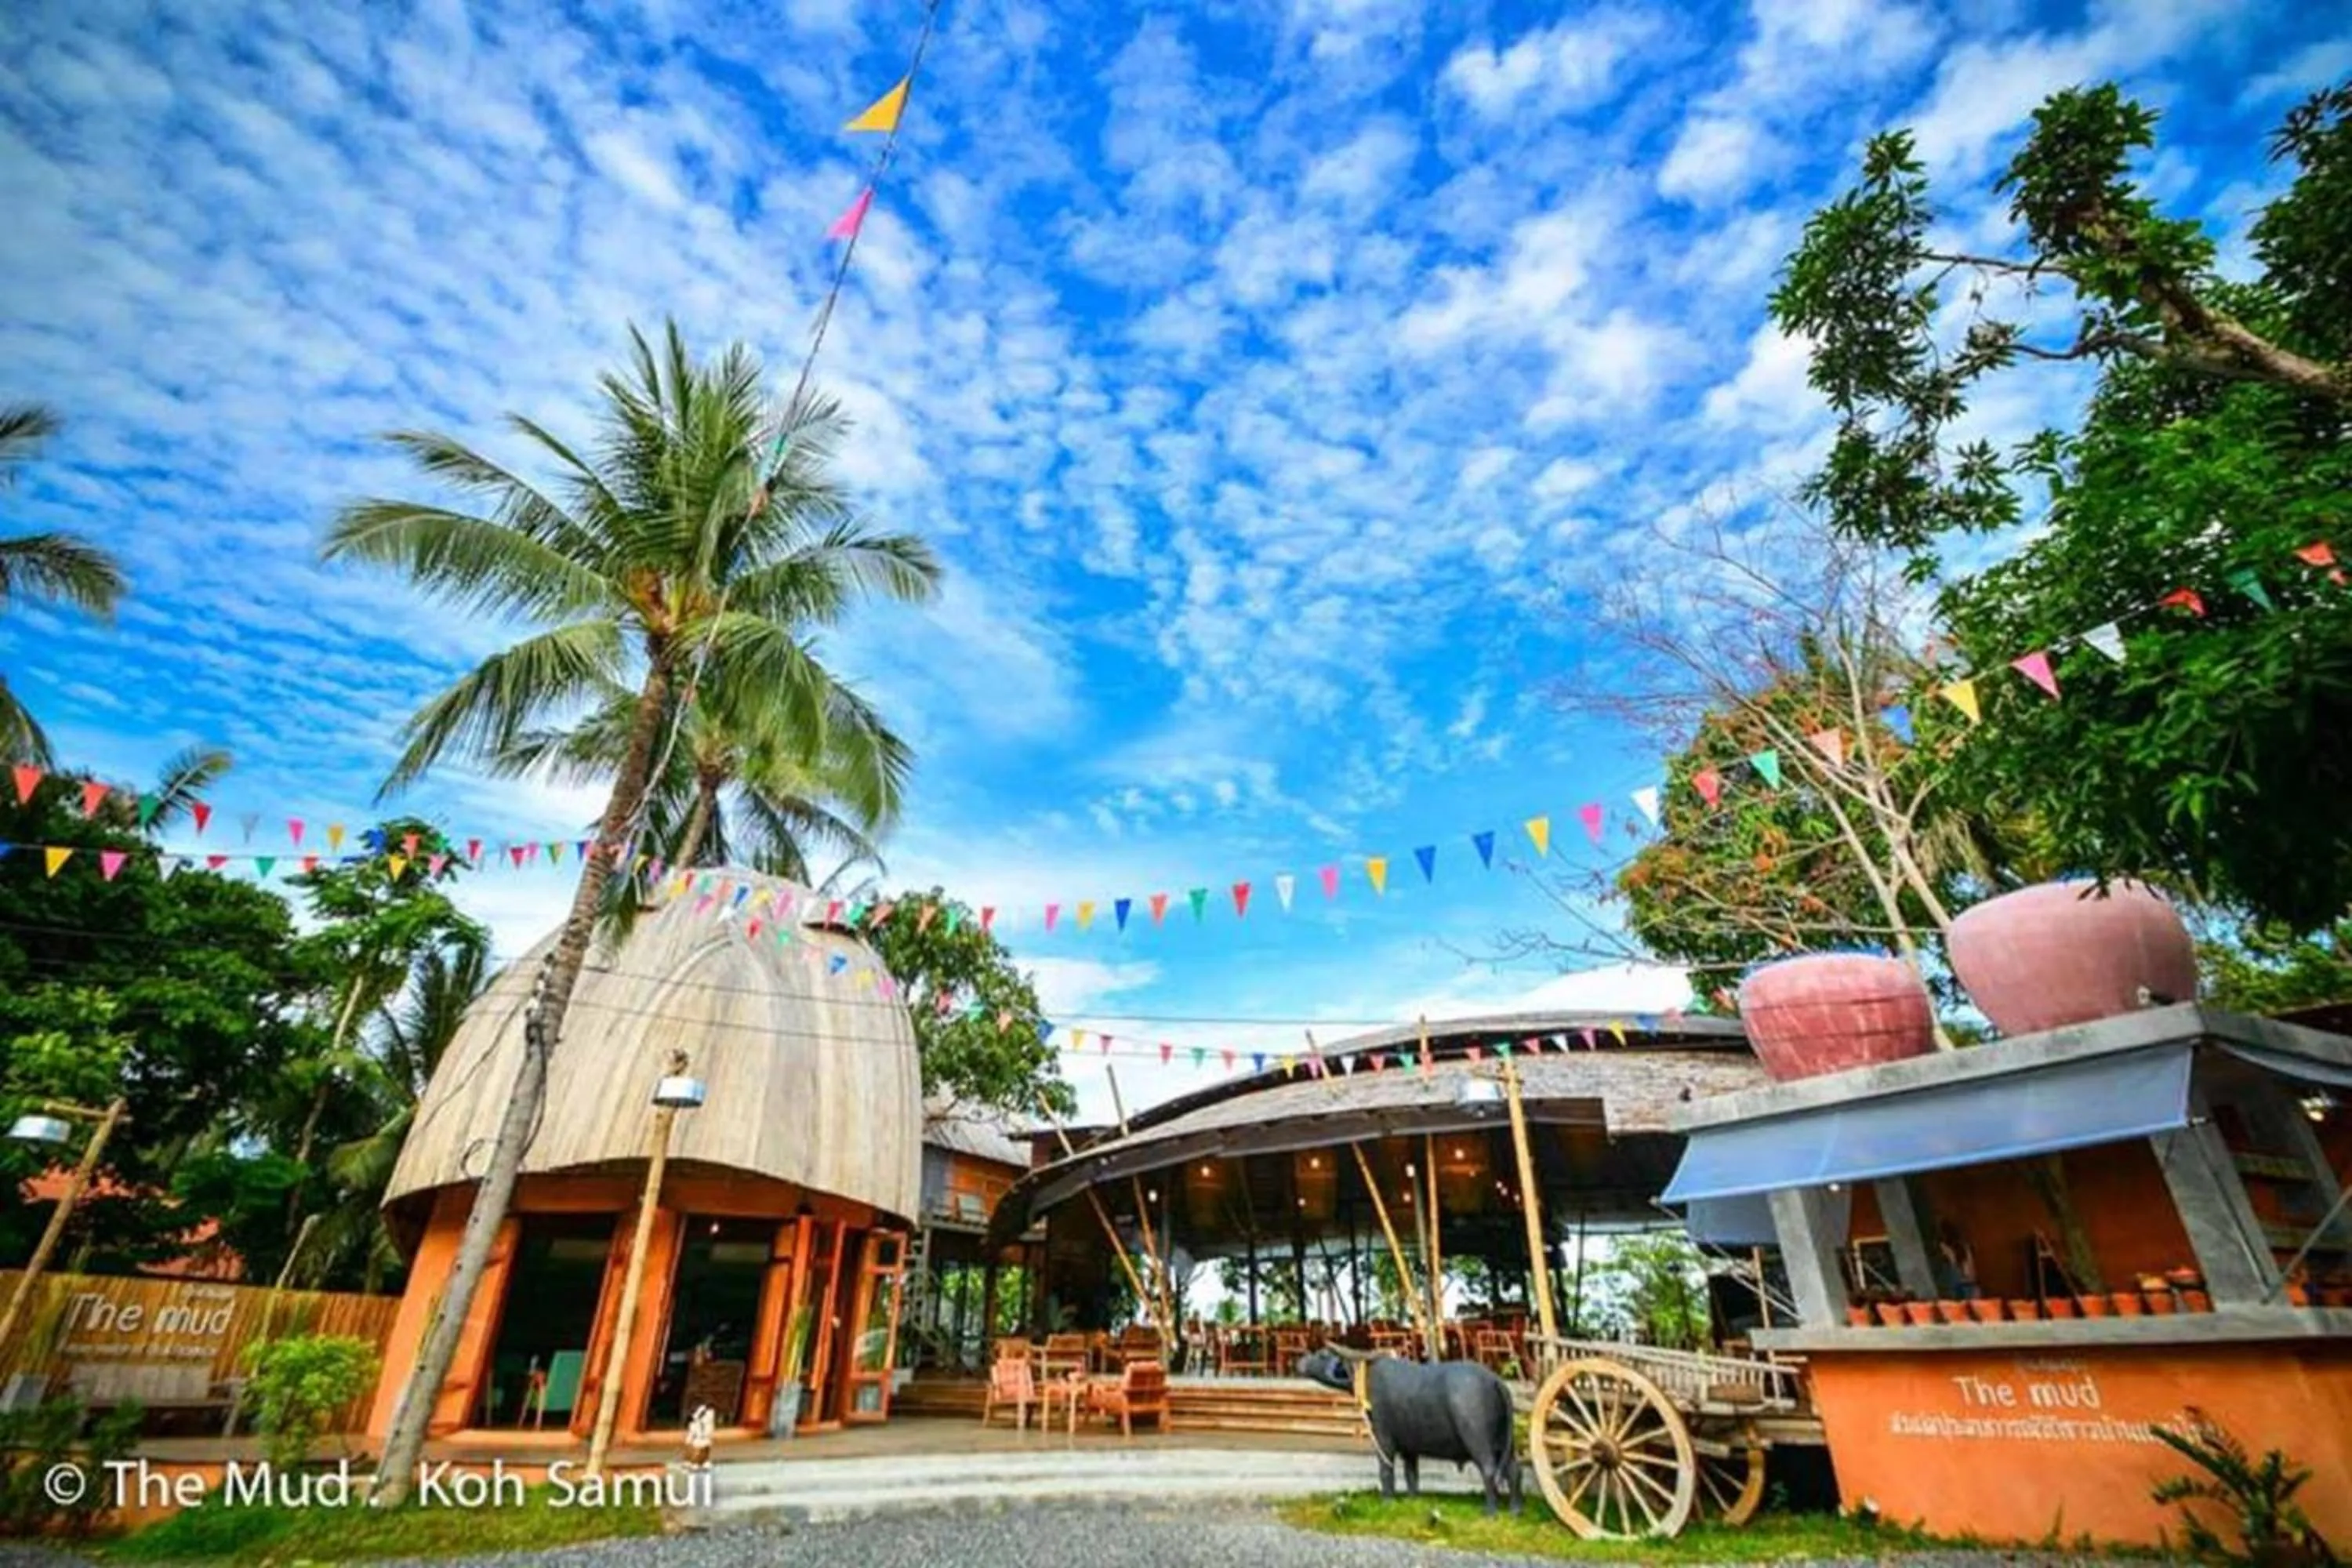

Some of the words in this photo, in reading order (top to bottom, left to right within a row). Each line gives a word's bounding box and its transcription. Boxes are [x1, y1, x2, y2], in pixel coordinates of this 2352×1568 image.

[68, 1293, 143, 1332] The
[153, 1296, 235, 1334] mud
[1951, 1373, 2017, 1408] The
[2028, 1374, 2101, 1410] mud
